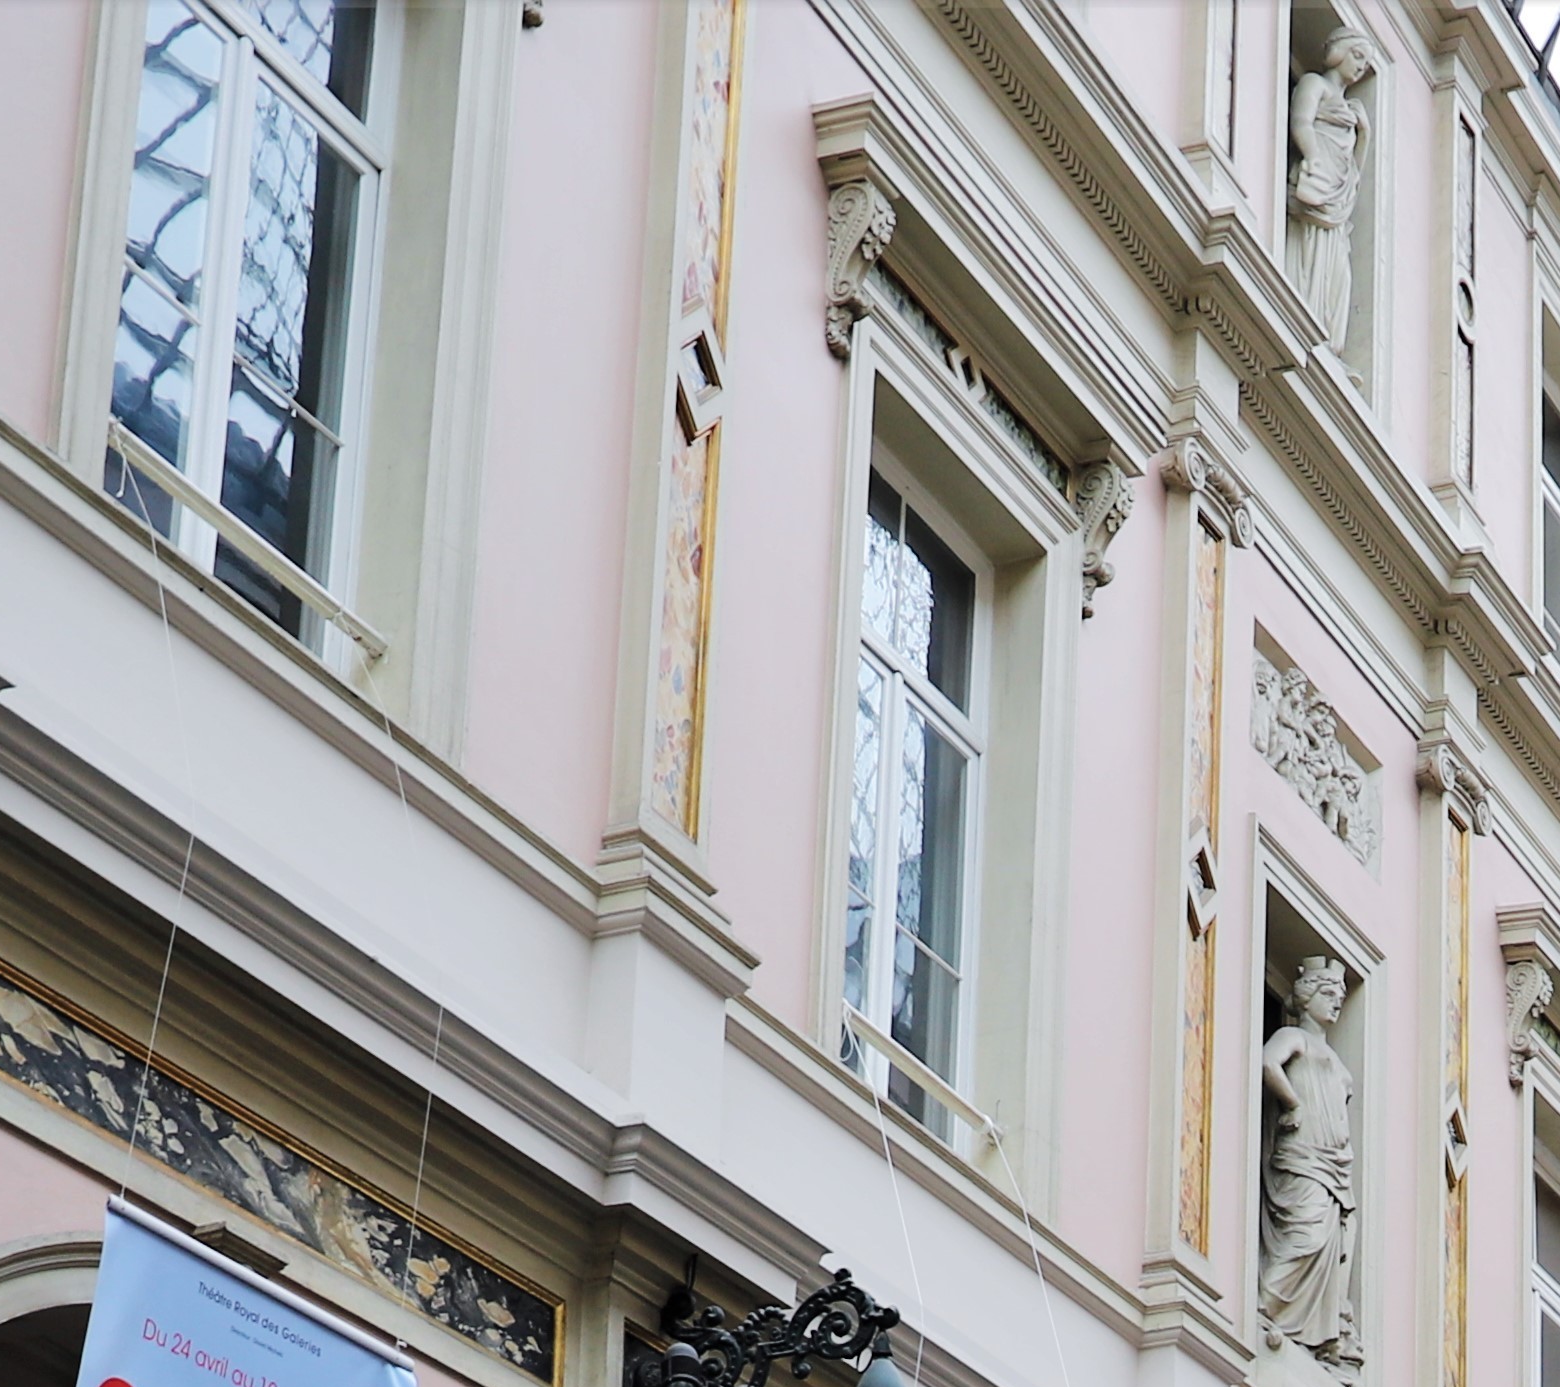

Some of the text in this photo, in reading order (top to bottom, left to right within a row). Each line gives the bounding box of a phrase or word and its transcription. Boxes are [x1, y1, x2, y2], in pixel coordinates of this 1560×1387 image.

[142, 1318, 166, 1347] Du
[171, 1333, 191, 1359] 24
[195, 1350, 229, 1379] avril
[198, 1281, 232, 1311] Théâtre
[234, 1301, 260, 1323] Royal
[261, 1317, 279, 1335] des
[281, 1327, 322, 1357] Galeries
